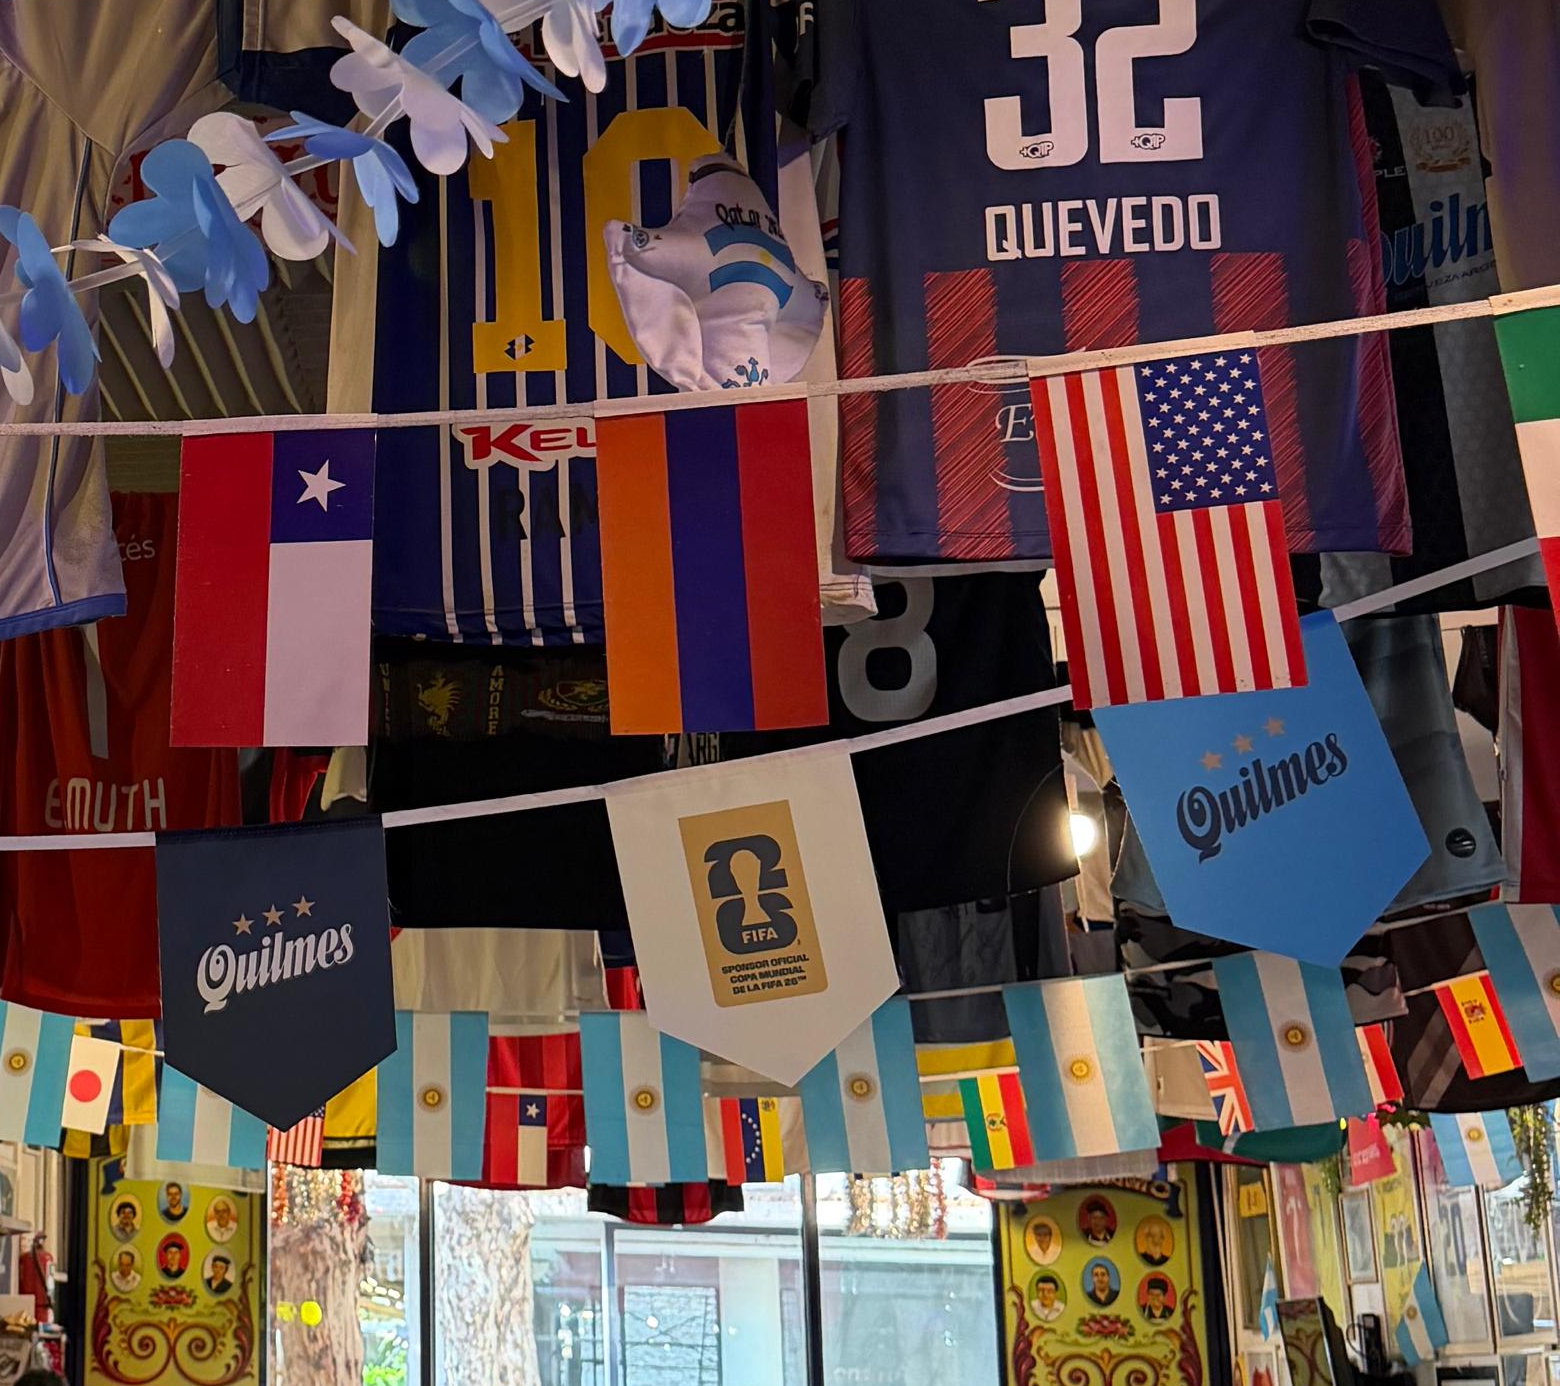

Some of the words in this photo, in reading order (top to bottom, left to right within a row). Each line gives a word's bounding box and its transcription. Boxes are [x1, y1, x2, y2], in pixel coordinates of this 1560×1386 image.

[984, 194, 1221, 262] QUEVEDO
[1176, 732, 1348, 865] Quilmes
[742, 927, 779, 945] FIFA
[196, 920, 355, 1014] Quilmes
[721, 959, 770, 975] SPONSOR
[770, 953, 810, 968] OFICIAL
[730, 972, 757, 985] COPA
[758, 966, 806, 981] MUNDIAL
[732, 986, 746, 996] DE
[747, 983, 760, 993] LA
[761, 979, 783, 991] FIFA
